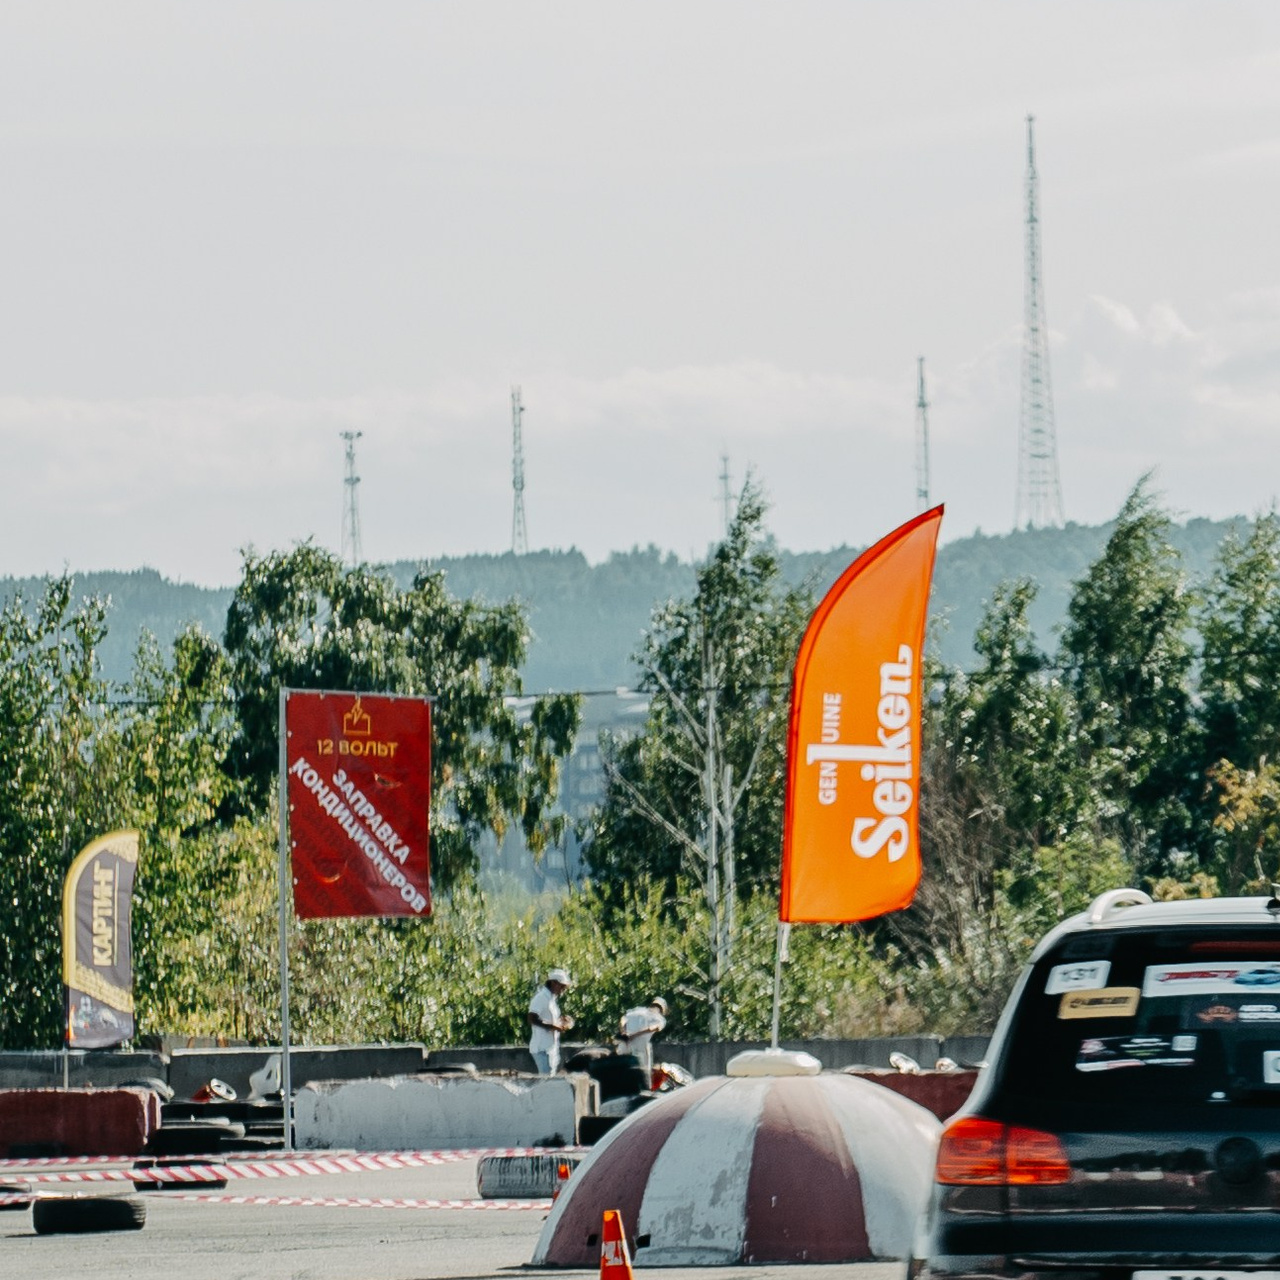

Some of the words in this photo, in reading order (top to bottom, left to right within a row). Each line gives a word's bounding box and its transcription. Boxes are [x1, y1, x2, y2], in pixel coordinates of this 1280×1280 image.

[317, 739, 334, 756] 12
[339, 740, 399, 758] ВОЛЬТ
[807, 644, 913, 863] Seiken
[289, 756, 428, 914] КОНДИЦИОНЕРОВ
[332, 768, 411, 865] ЗАПРАВКА
[92, 859, 114, 967] КАРТИНГ
